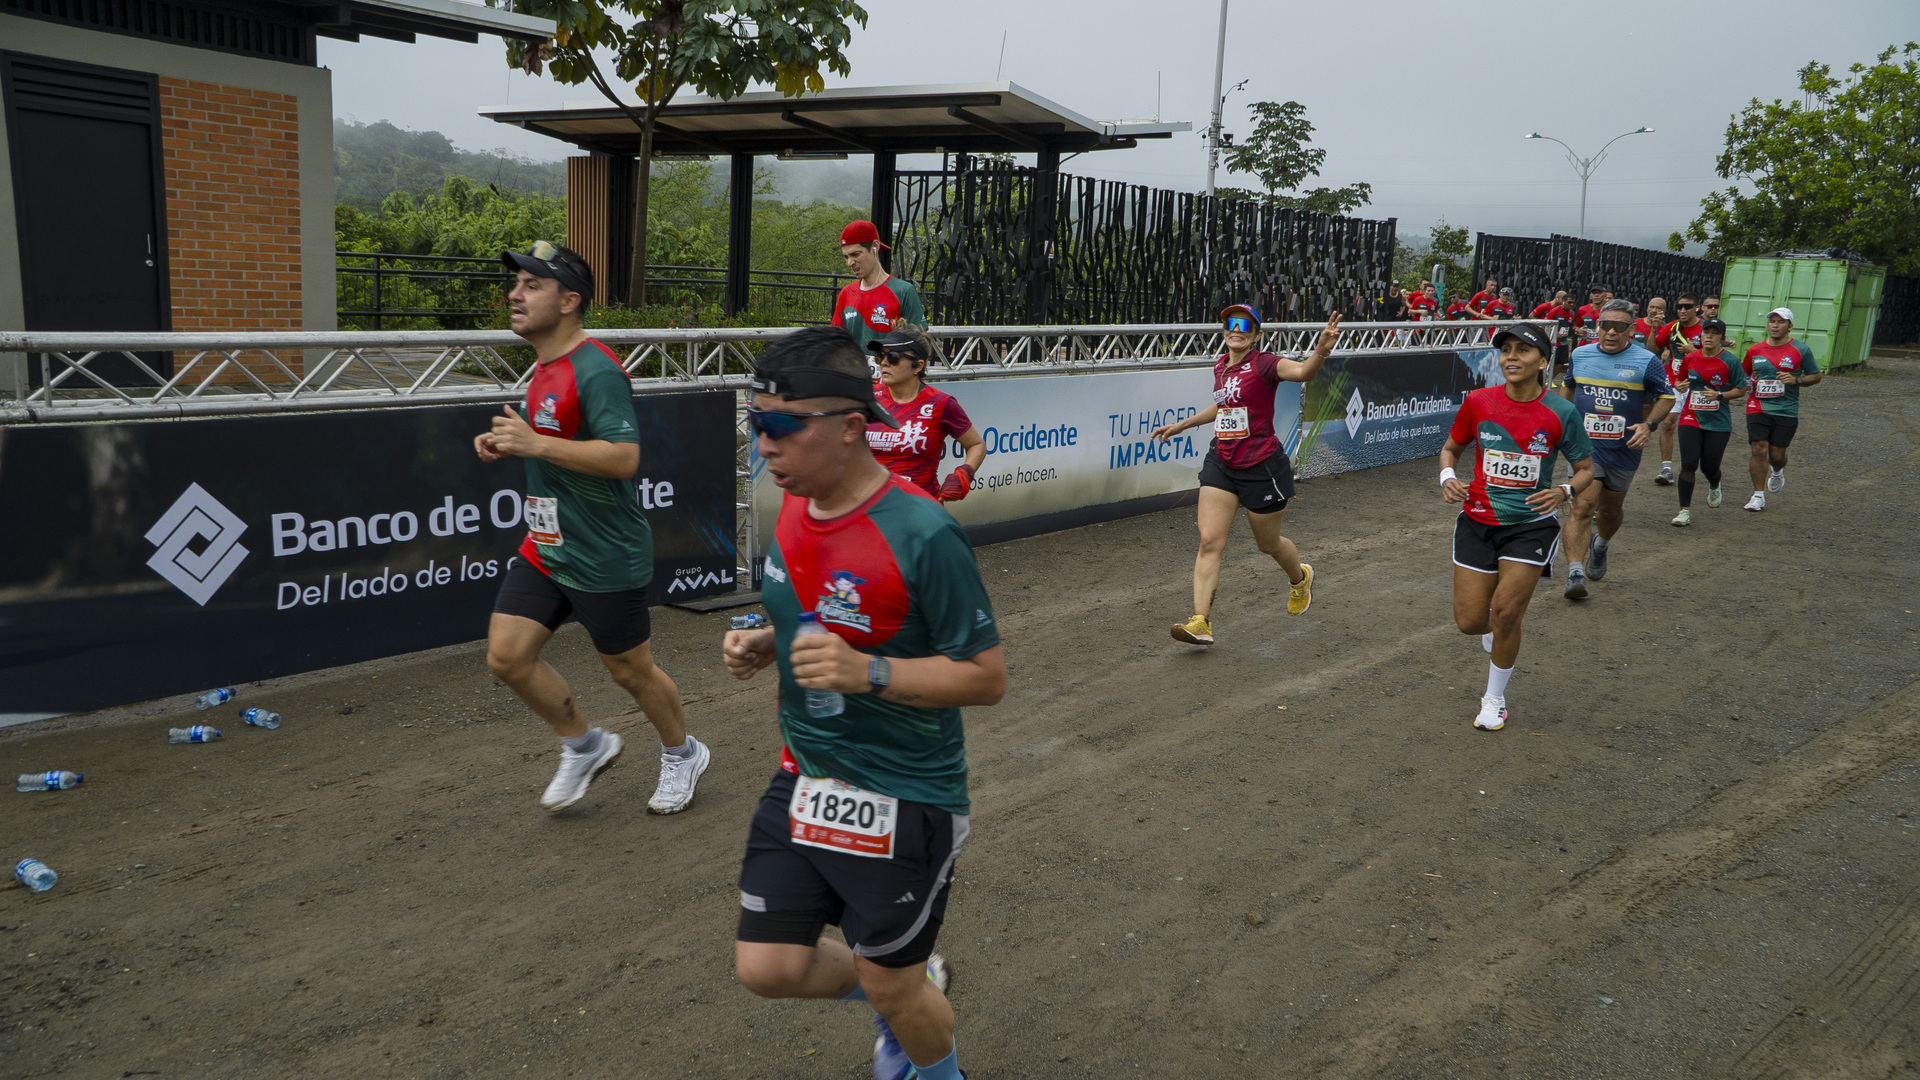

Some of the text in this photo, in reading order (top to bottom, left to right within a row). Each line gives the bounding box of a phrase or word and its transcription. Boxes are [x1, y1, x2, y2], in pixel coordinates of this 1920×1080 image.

[1583, 385, 1628, 401] CARLOS
[1761, 385, 1777, 393] 275
[1366, 395, 1451, 421] Banco de Occidente
[1594, 397, 1614, 407] COL
[1108, 413, 1132, 438] TU
[1220, 418, 1238, 430] 538
[1364, 430, 1377, 445] Del
[1376, 428, 1391, 443] lado
[1391, 426, 1400, 440] de
[1400, 425, 1410, 439] los
[1410, 427, 1421, 440] que
[1593, 422, 1614, 432] 610
[865, 431, 902, 442] THLETIC
[983, 423, 1078, 455] Occidente
[1109, 435, 1199, 470] IMPACTA.
[969, 466, 1058, 493] os que hacen.
[1492, 462, 1529, 478] 1843
[271, 511, 418, 557] Banco
[429, 495, 481, 537] de
[667, 569, 734, 594] AVAL
[675, 566, 702, 576] Grupo
[277, 574, 330, 610] Del
[340, 566, 408, 600] lado
[415, 559, 452, 588] de
[460, 555, 498, 581] los
[810, 791, 875, 829] 1820
